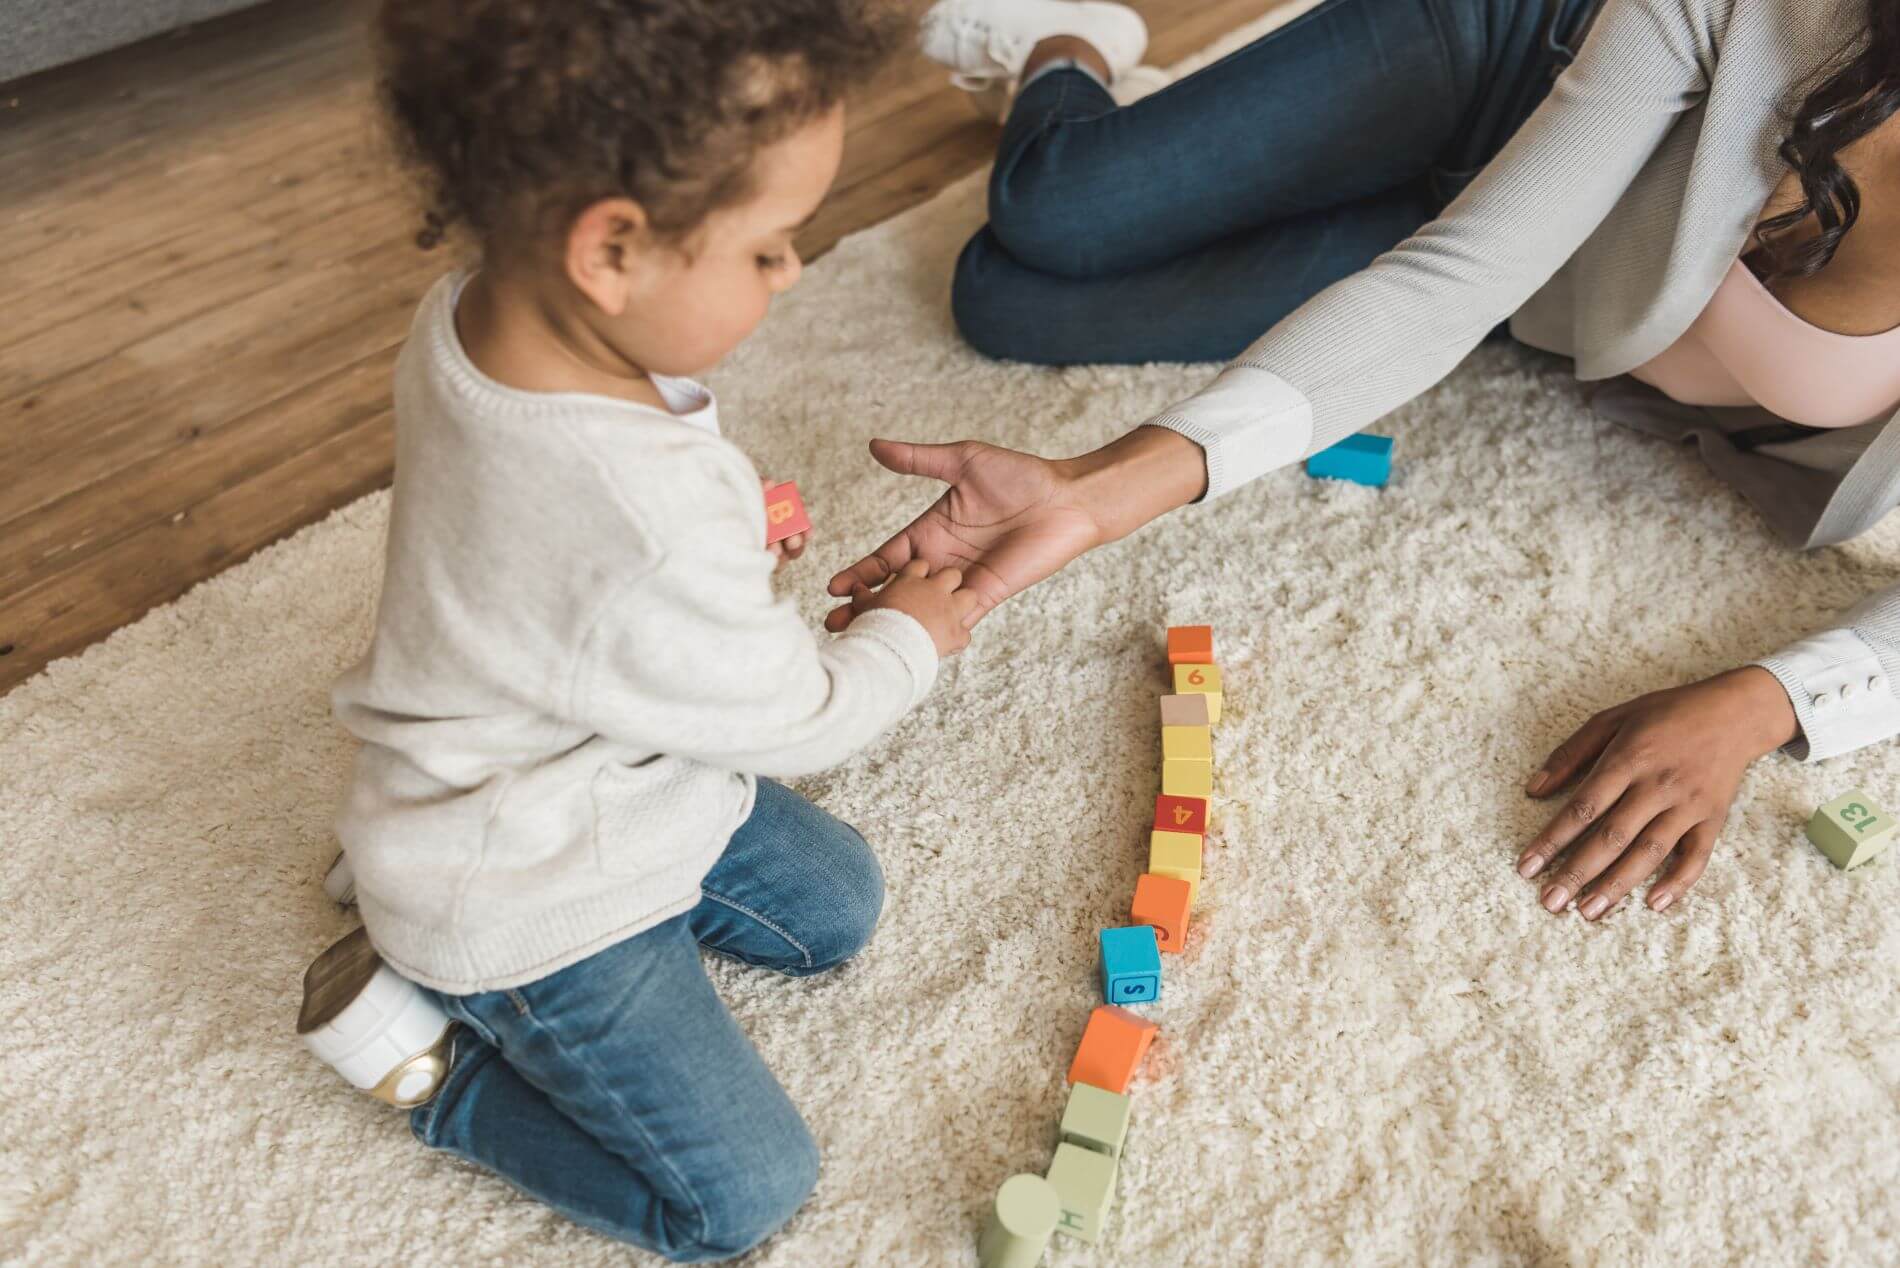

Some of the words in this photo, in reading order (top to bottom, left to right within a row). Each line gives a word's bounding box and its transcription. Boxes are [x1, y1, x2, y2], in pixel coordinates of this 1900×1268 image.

[767, 499, 795, 525] B
[1172, 804, 1195, 825] 4
[1839, 802, 1878, 833] 13
[1057, 1207, 1084, 1231] H
